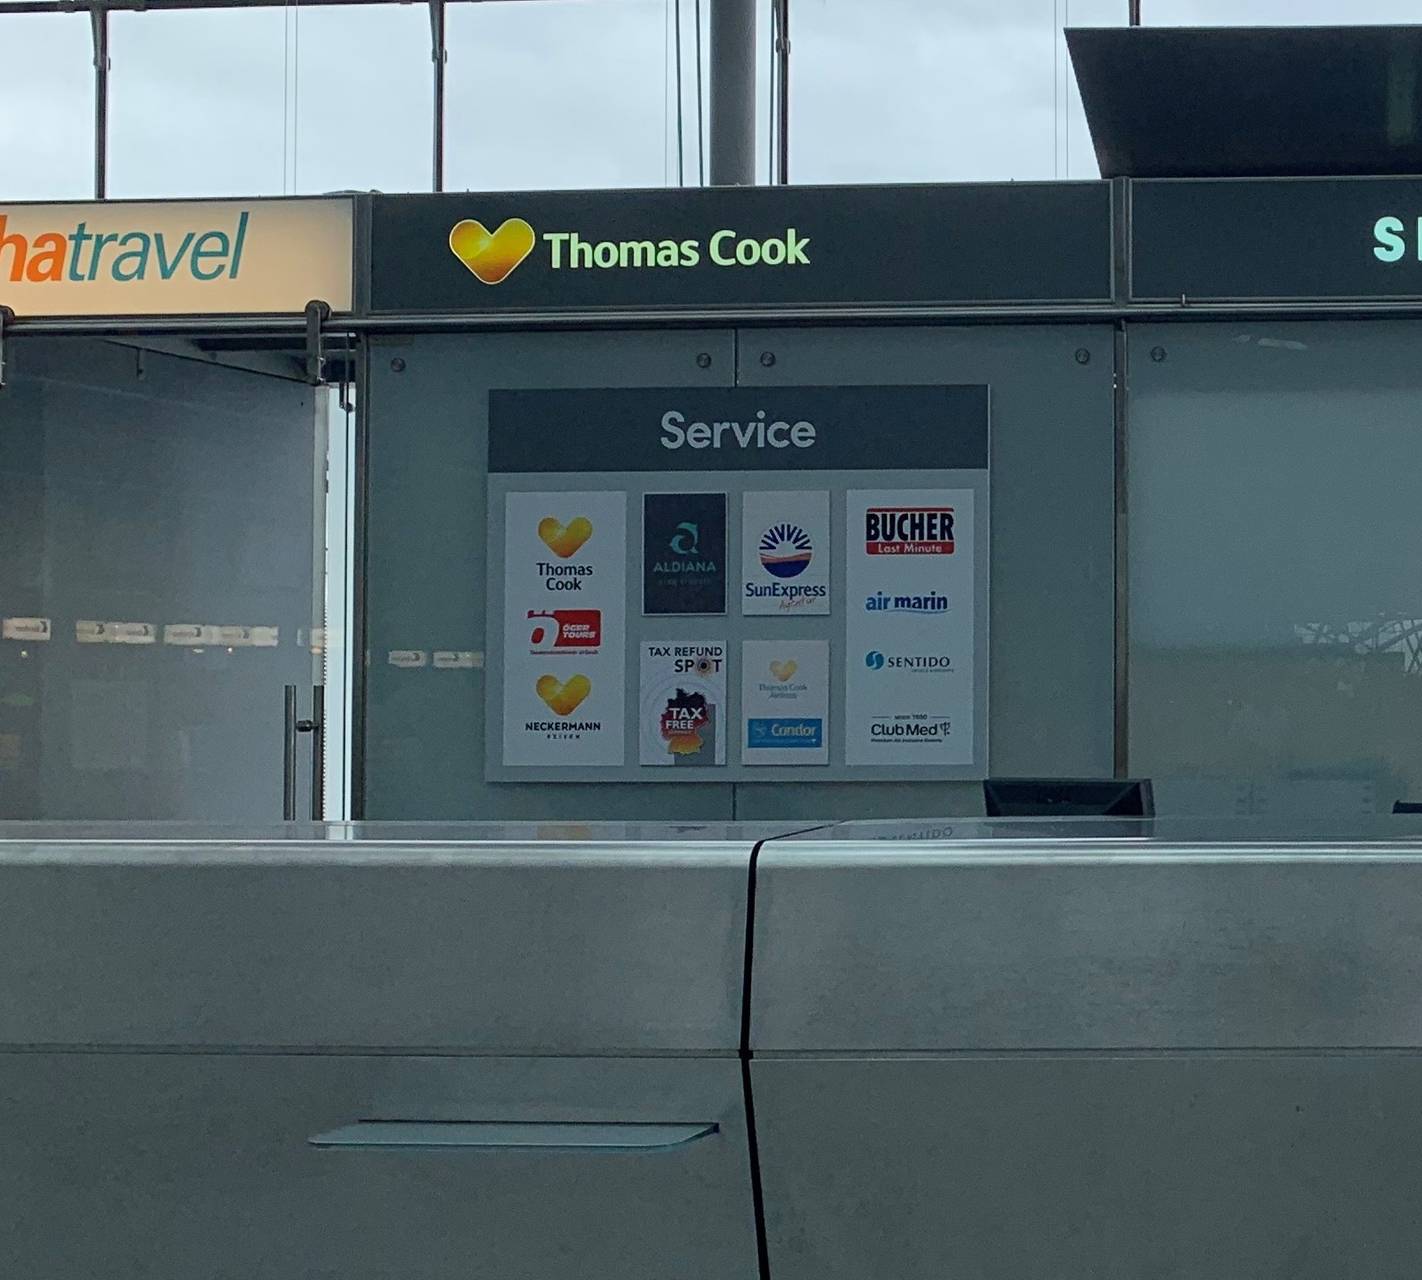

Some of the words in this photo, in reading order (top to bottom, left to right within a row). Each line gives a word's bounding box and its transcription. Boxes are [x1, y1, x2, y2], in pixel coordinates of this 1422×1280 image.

[543, 232, 700, 269] Thomas
[709, 228, 811, 267] Cook
[660, 410, 816, 449] Service
[866, 513, 955, 541] BUCHER
[878, 543, 900, 553] Last
[904, 543, 943, 553] Minute
[536, 563, 593, 576] Thomas
[653, 561, 716, 573] ALDIANA
[546, 578, 582, 591] Cook
[745, 582, 826, 600] SunExpress
[865, 591, 891, 610] air
[894, 591, 948, 610] marin
[648, 647, 671, 656] TAX
[674, 647, 723, 656] REFUND
[887, 656, 950, 668] SENTIDO
[668, 707, 703, 719] TAX
[525, 722, 601, 731] NECKERMANN
[665, 720, 694, 730] FREE
[771, 723, 817, 737] Condor
